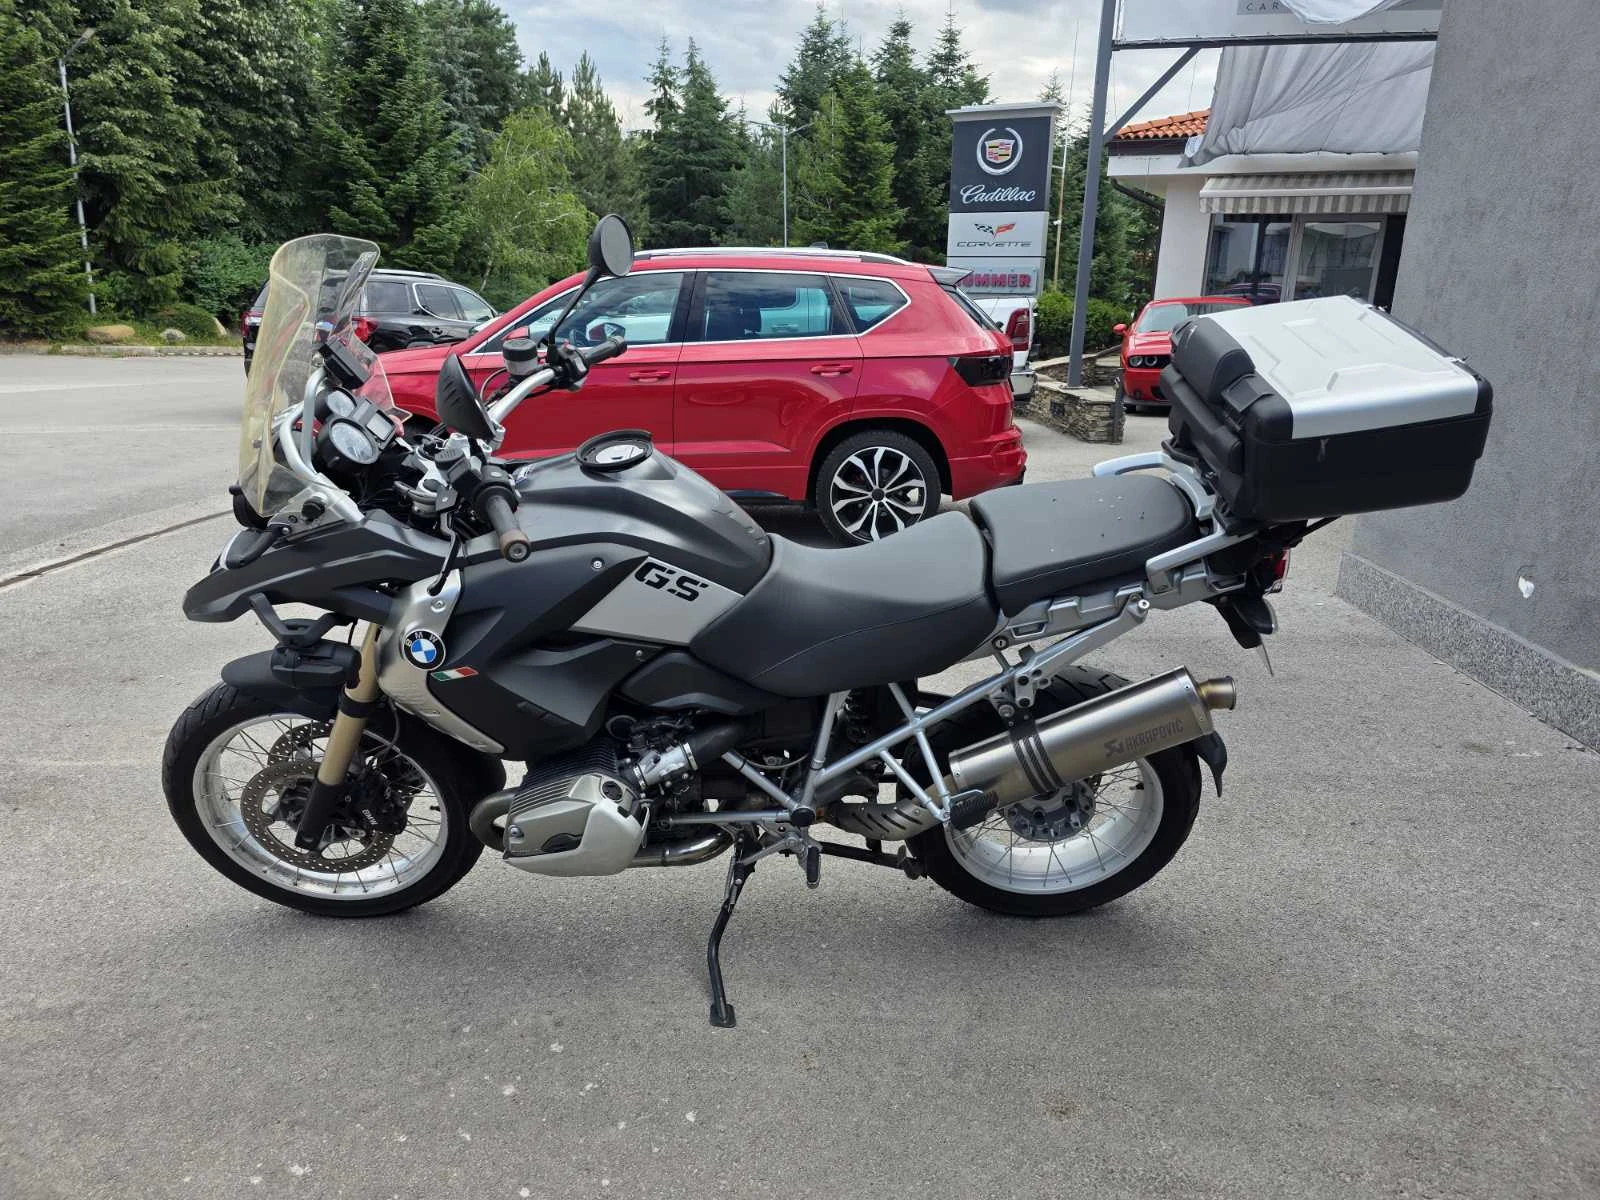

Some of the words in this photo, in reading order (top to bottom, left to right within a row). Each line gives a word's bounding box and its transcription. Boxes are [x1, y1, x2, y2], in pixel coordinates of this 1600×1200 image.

[960, 184, 1036, 204] Cadillac
[957, 273, 1032, 288] UMMER
[635, 562, 709, 601] GS
[406, 632, 438, 647] BMW
